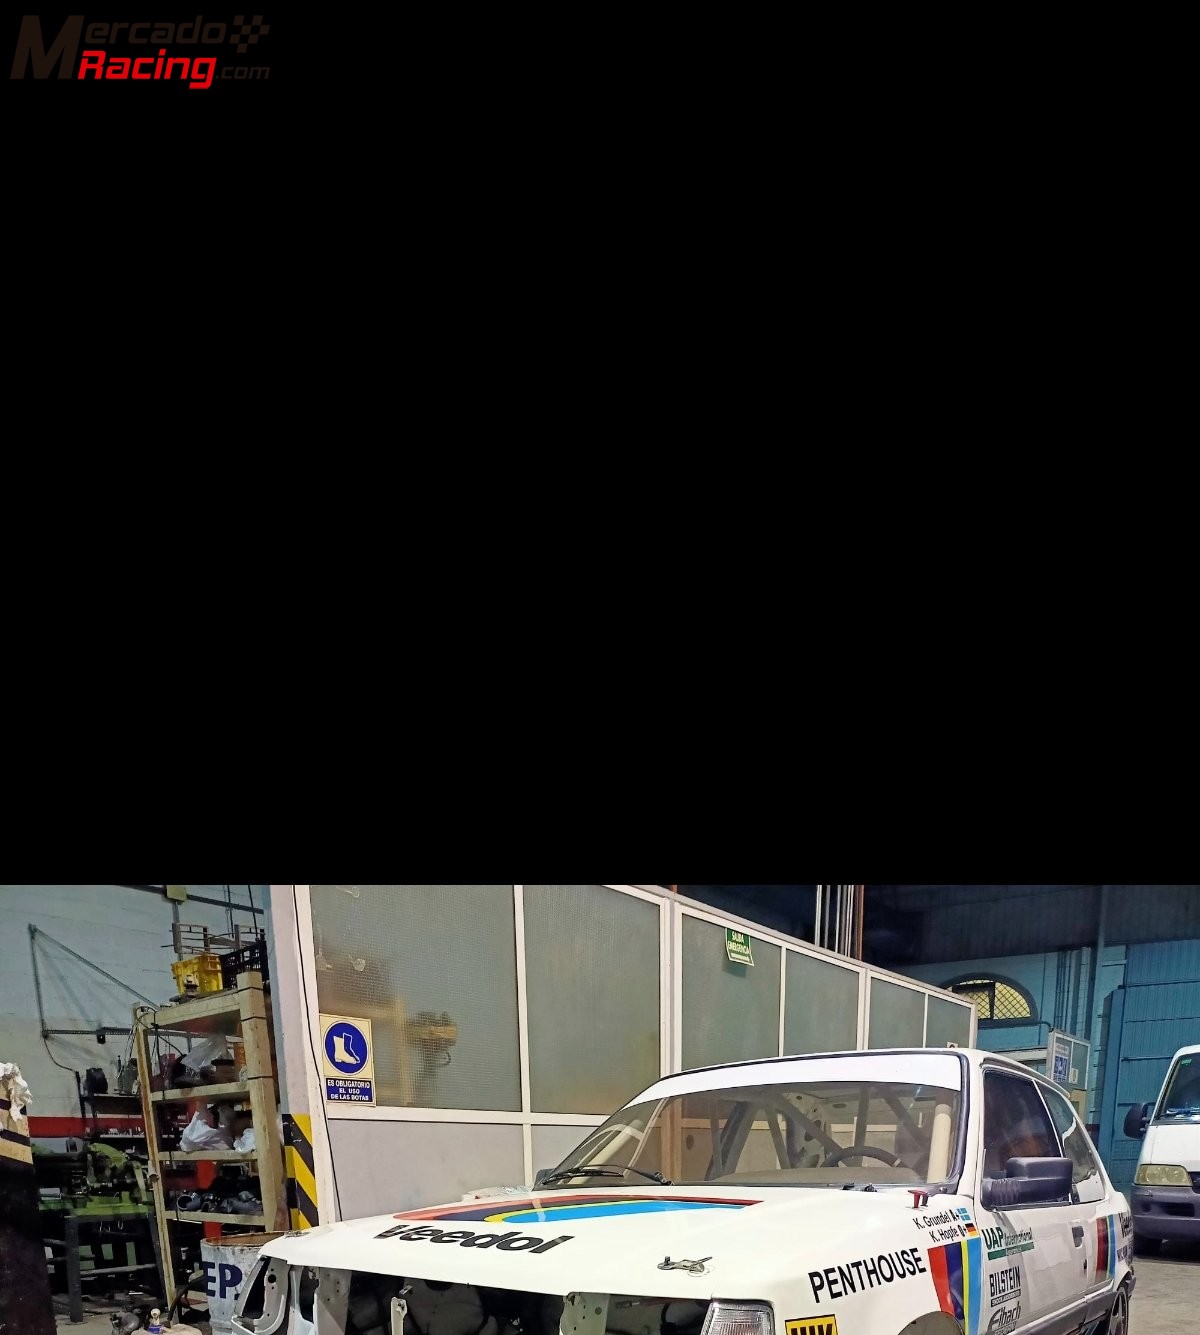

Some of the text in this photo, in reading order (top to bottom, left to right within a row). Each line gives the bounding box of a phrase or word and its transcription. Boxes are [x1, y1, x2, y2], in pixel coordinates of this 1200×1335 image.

[335, 1080, 371, 1089] OBLIGATORIO
[912, 1217, 926, 1230] K.
[929, 1230, 940, 1243] K.
[373, 1224, 575, 1254] Veedol
[981, 1226, 1003, 1250] UAP
[202, 1261, 243, 1301] EP
[808, 1247, 927, 1304] PENTHOUSE
[989, 1265, 1021, 1298] BILSTEIN
